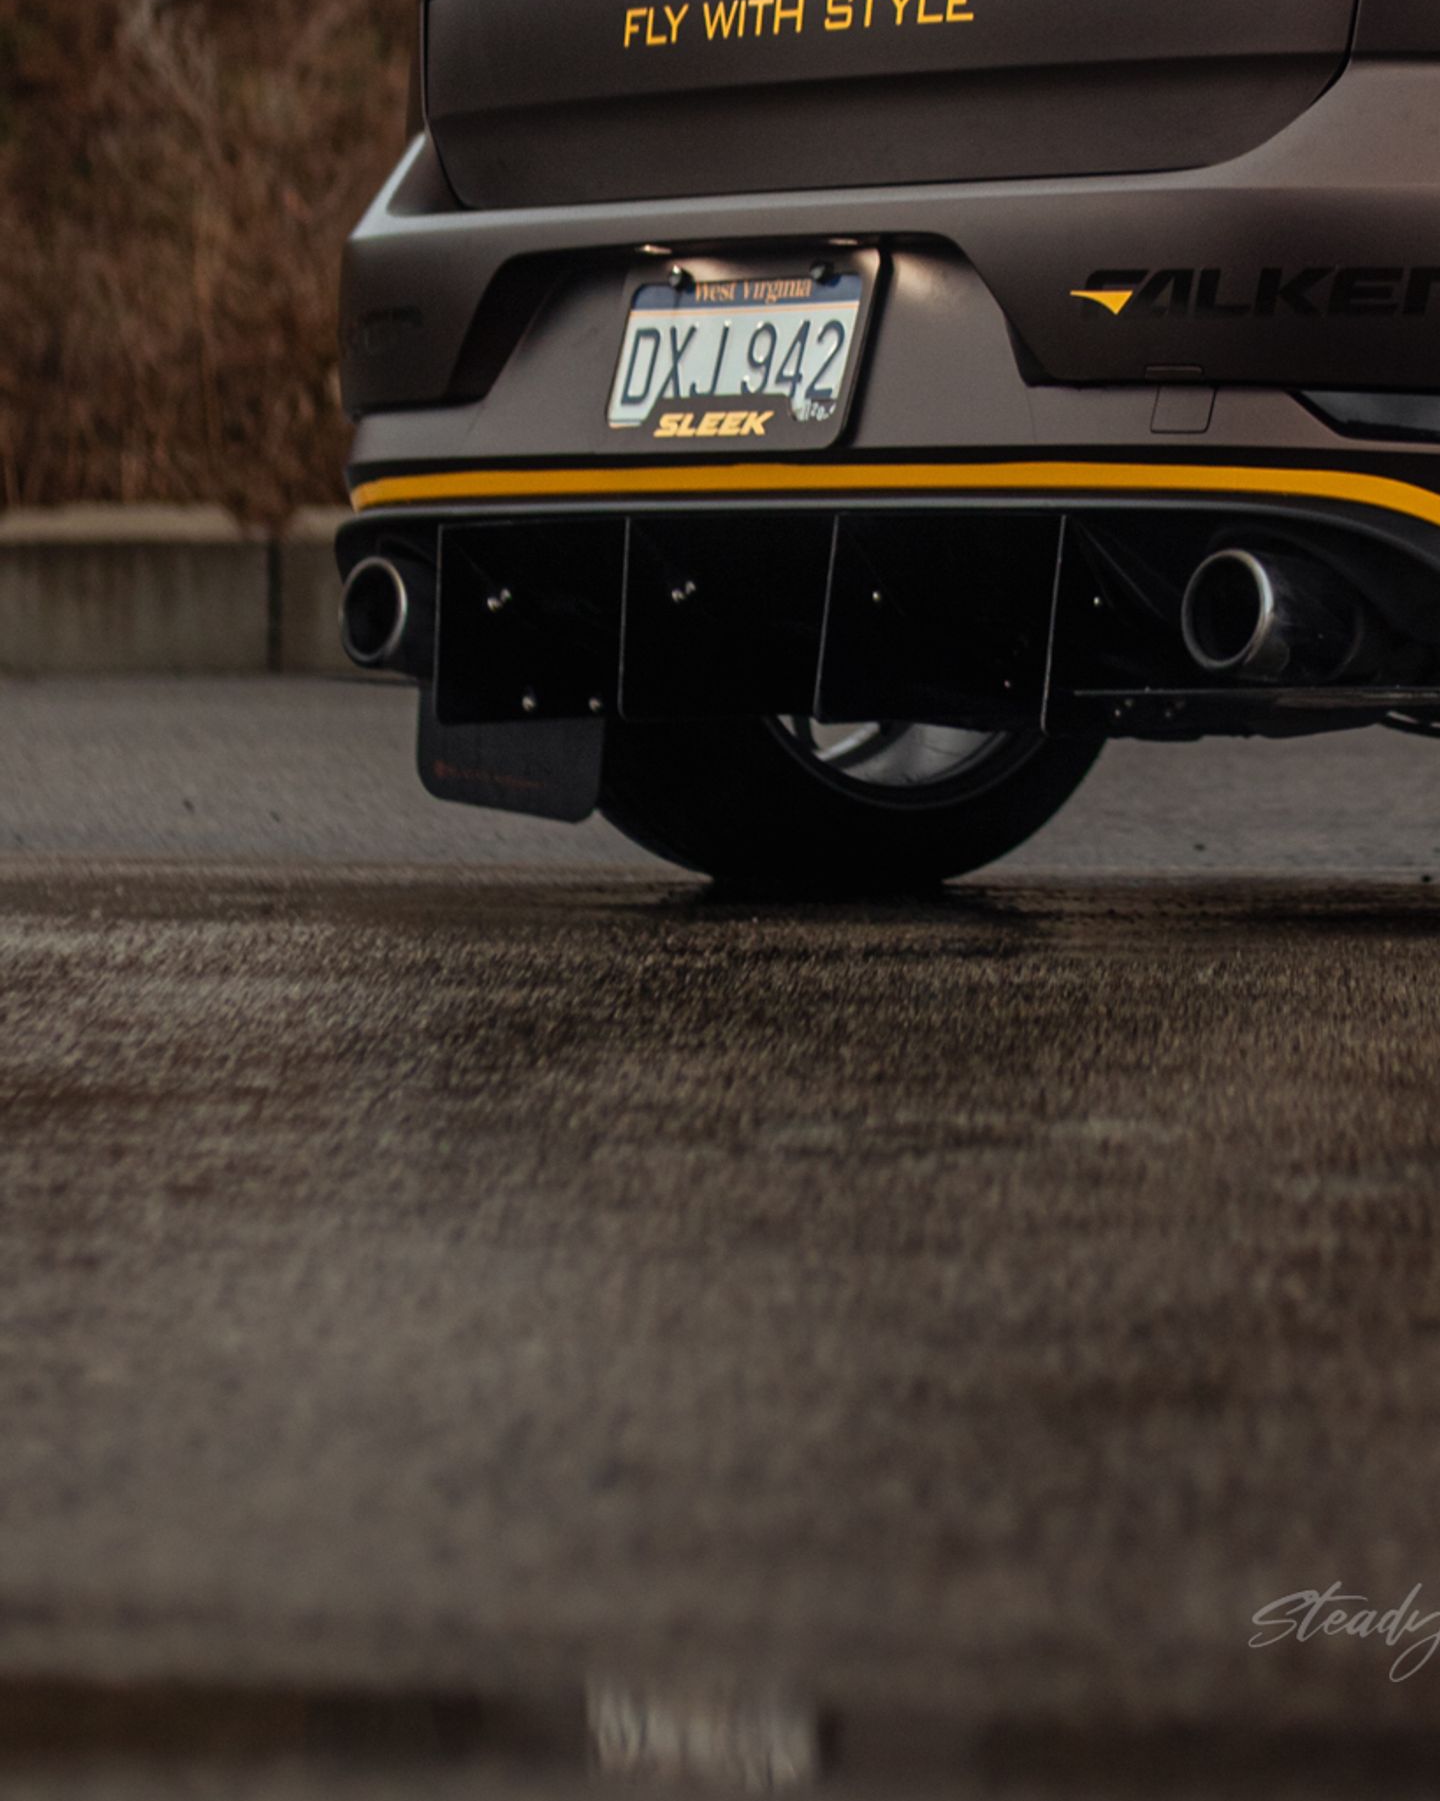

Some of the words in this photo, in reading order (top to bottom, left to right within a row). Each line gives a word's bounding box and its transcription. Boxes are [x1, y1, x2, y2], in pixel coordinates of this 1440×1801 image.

[624, 3, 689, 48] FLY
[695, 282, 737, 301] West
[743, 278, 813, 304] Virginia
[740, 319, 846, 400] 942
[653, 411, 775, 438] SLEEK
